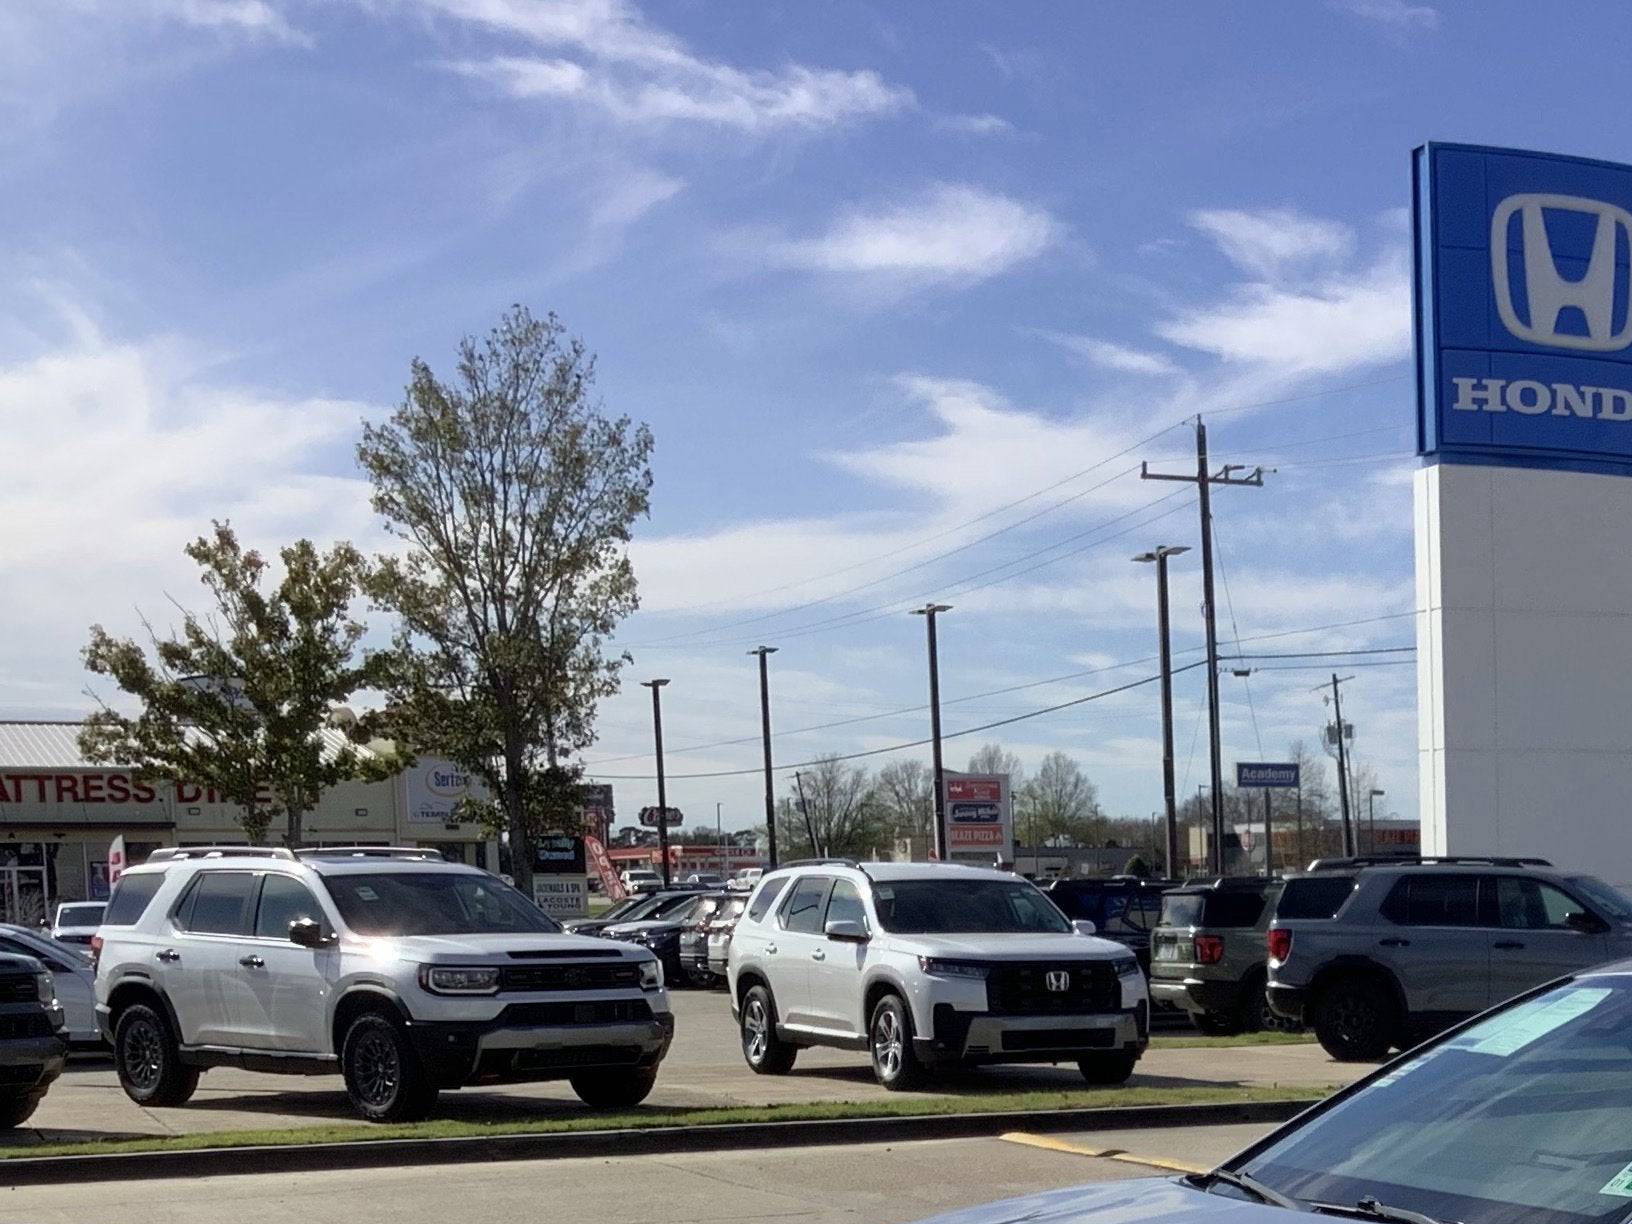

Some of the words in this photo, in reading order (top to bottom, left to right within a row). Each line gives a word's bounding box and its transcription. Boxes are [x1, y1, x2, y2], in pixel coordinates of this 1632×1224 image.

[1241, 768, 1296, 783] Academy
[0, 775, 155, 803] TTRESS
[974, 830, 994, 840] PIZZA
